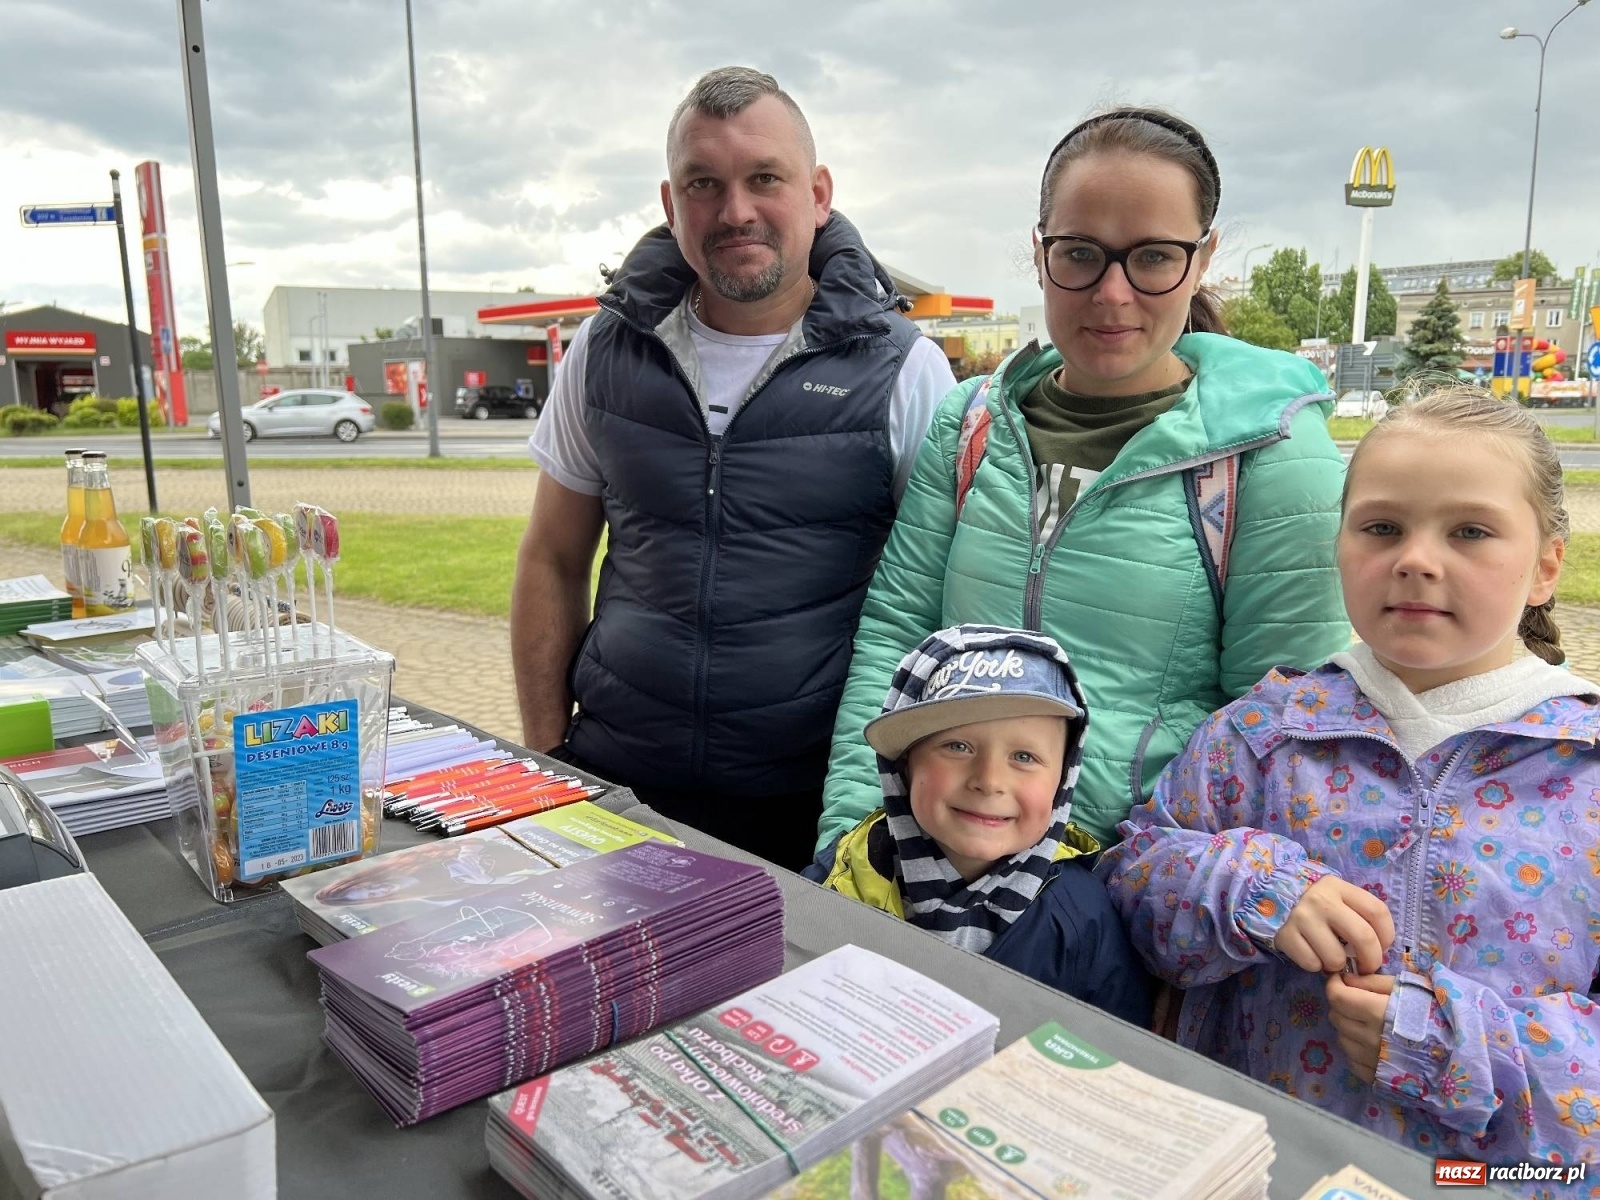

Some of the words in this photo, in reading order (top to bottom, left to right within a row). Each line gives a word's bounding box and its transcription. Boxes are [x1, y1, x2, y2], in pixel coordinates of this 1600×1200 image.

[1350, 190, 1393, 200] McDonald's
[948, 649, 1025, 694] York
[244, 709, 349, 748] LIZAKI
[246, 741, 328, 763] DESENIOWE
[330, 739, 339, 750] 8
[341, 741, 349, 751] g
[327, 775, 340, 784] 125
[330, 785, 335, 796] 1
[338, 784, 351, 795] kg
[558, 824, 607, 846] QUESTY
[649, 1045, 678, 1065] po
[687, 1027, 766, 1083] Raciborzu
[1043, 1038, 1076, 1060] GRA
